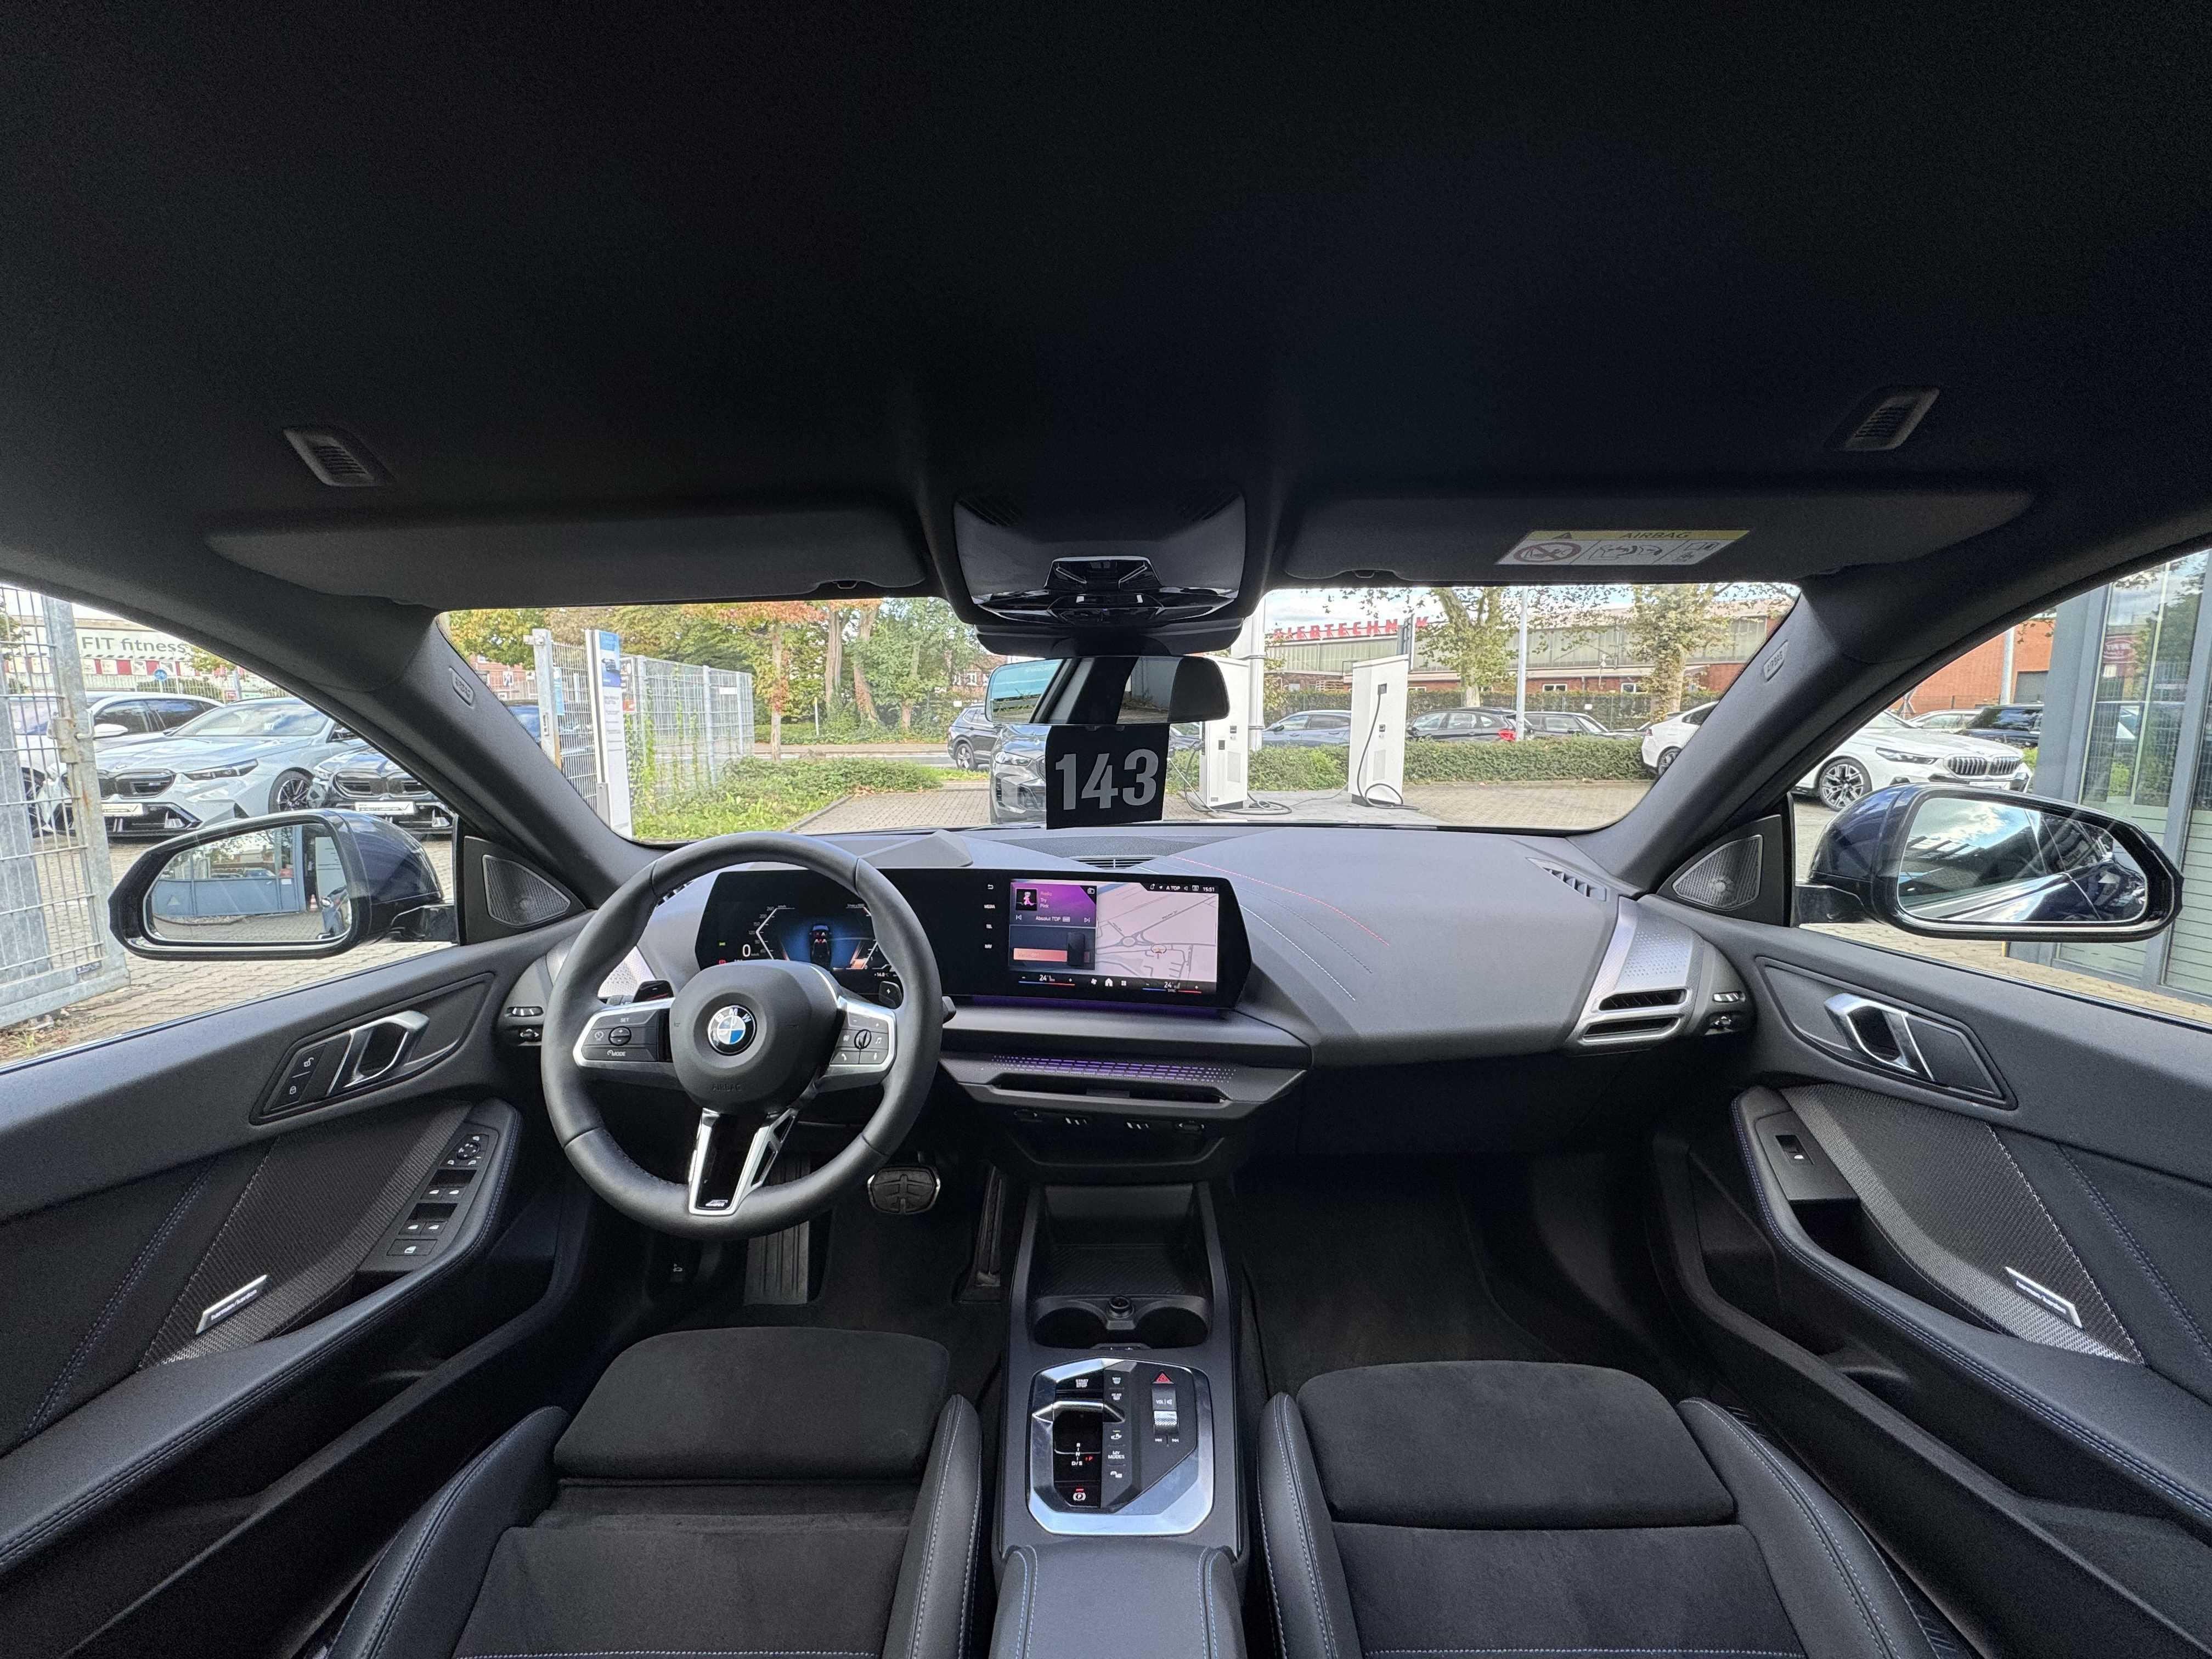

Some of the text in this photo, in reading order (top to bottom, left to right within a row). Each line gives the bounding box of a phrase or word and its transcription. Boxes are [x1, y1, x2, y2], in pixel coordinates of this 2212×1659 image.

[1619, 531, 1691, 539] AIRBAG
[1273, 616, 1429, 640] SIEBTECHNK
[82, 636, 186, 653] FIT fitness
[1767, 651, 1782, 674] AIRBAG
[1055, 749, 1160, 812] 143
[742, 944, 751, 957] 0
[715, 1007, 752, 1023] BMW
